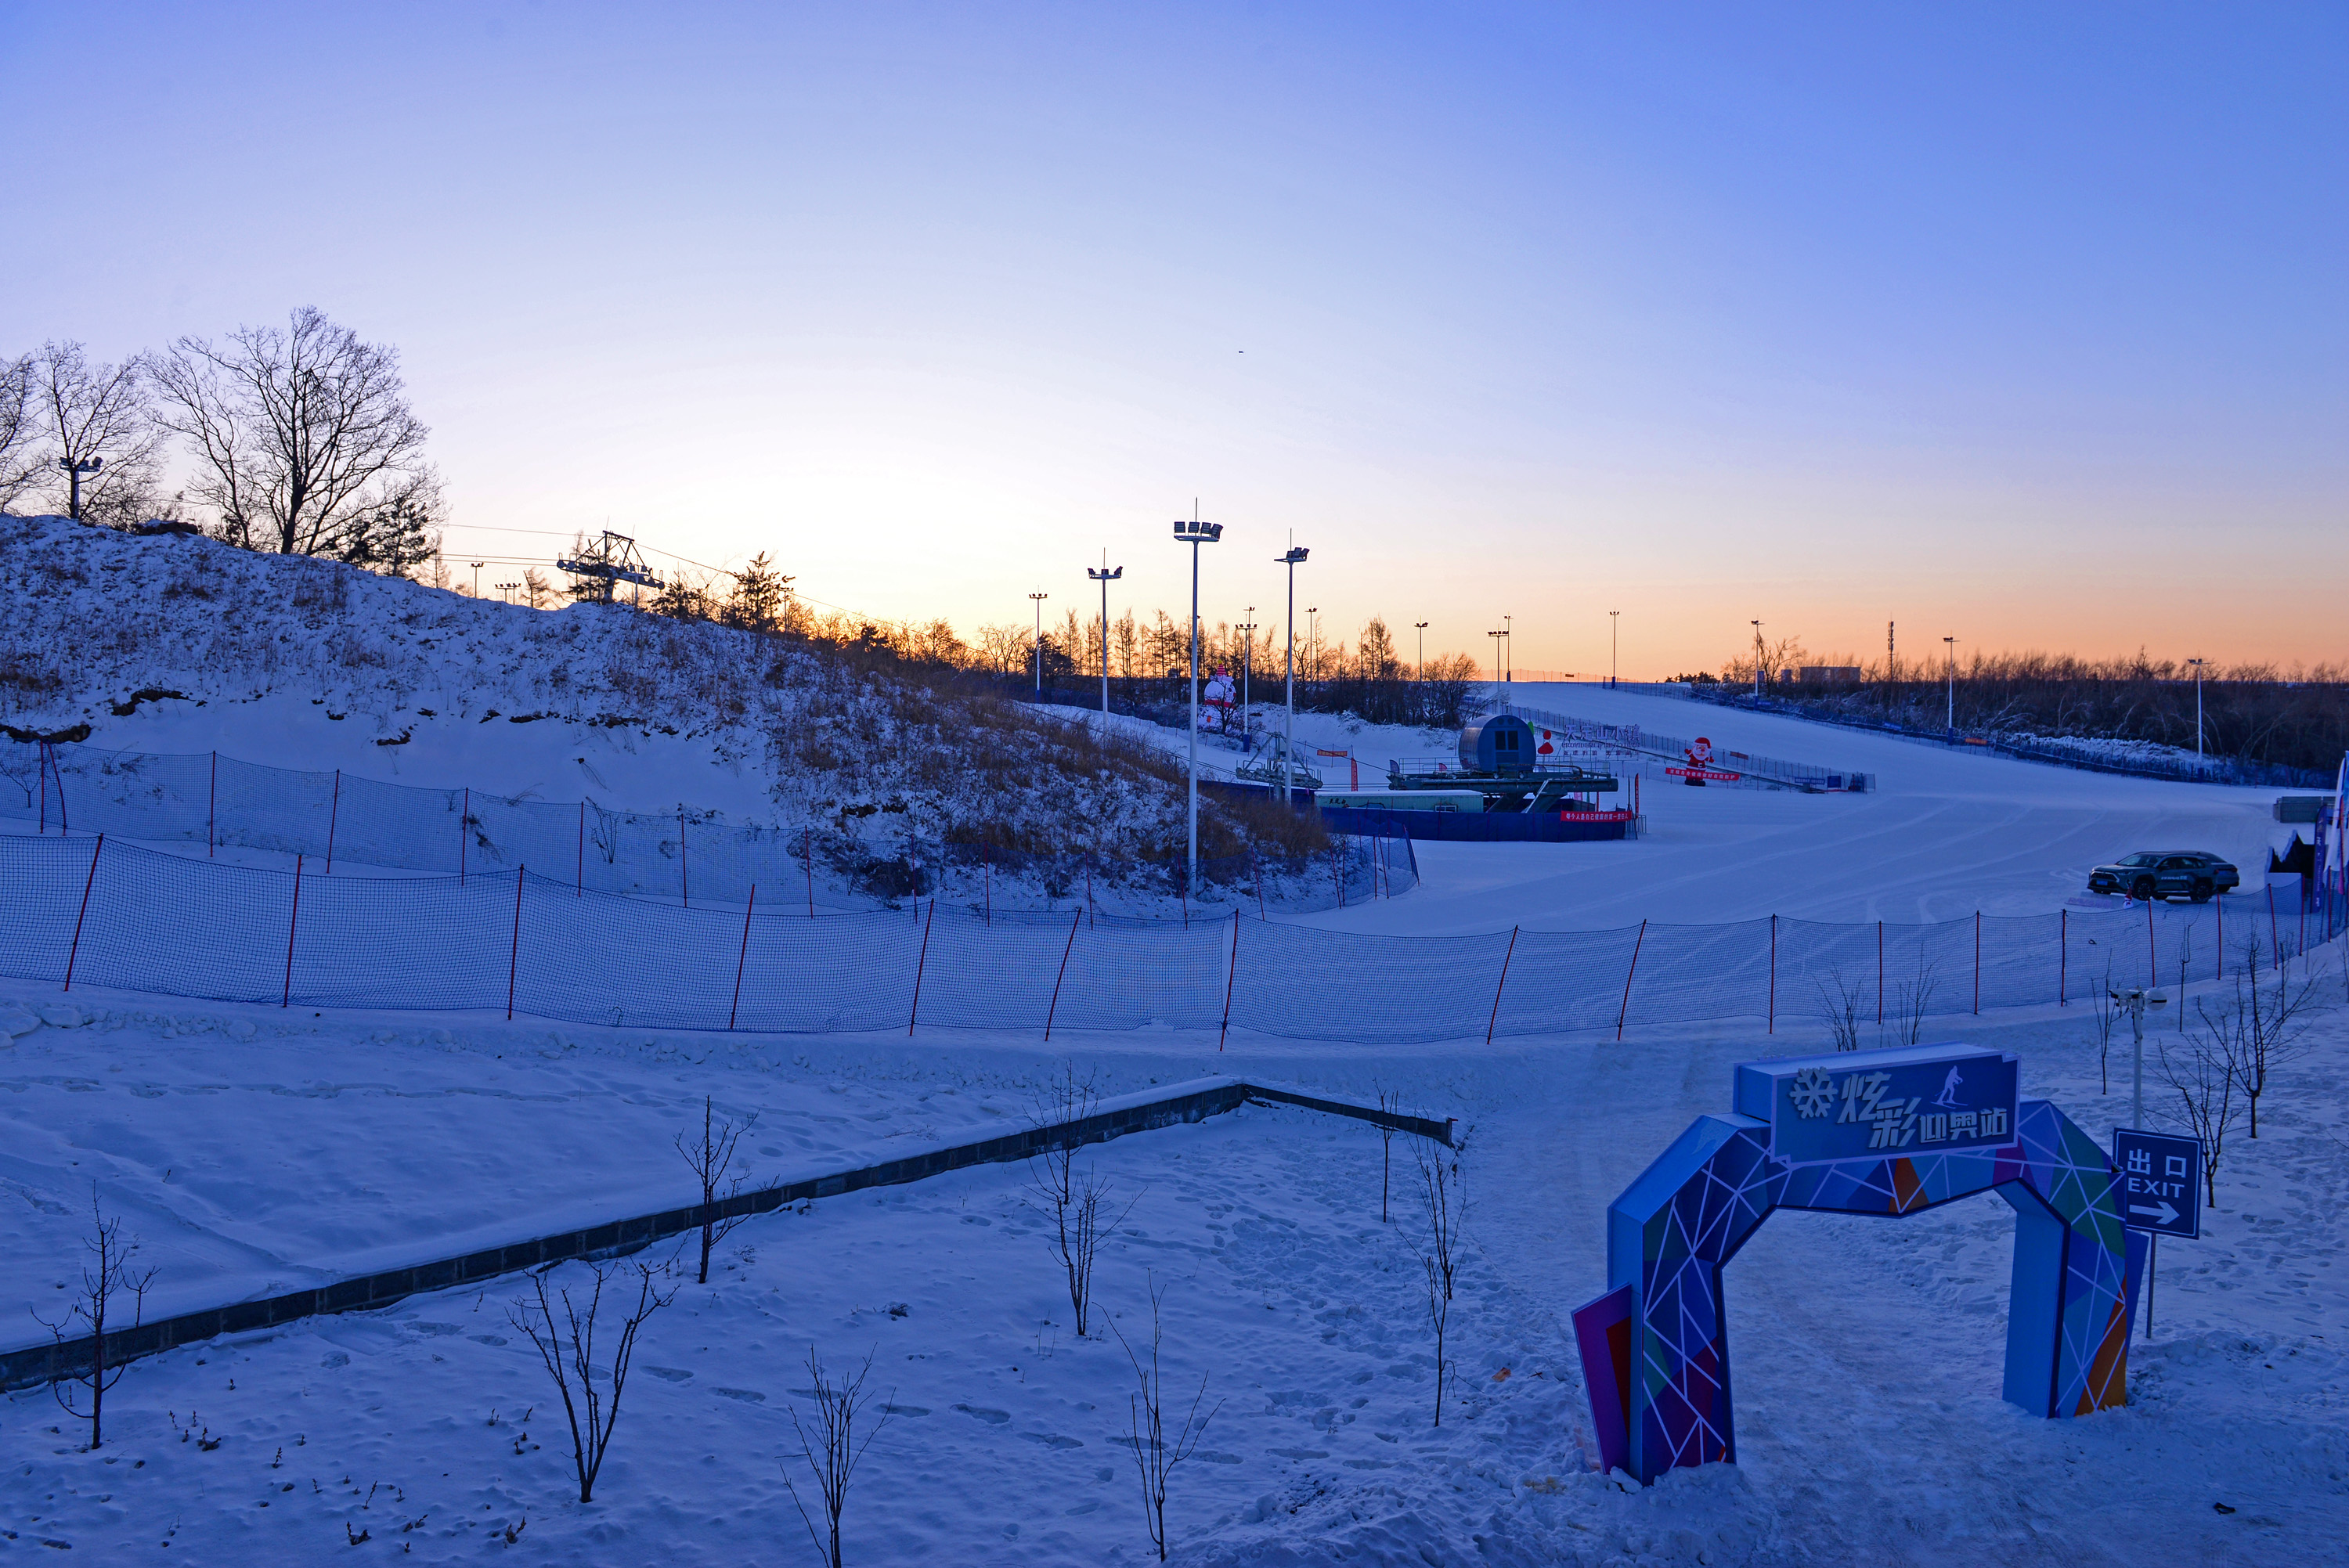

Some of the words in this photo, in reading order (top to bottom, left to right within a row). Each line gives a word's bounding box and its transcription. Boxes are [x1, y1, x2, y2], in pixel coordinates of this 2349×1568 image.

[1564, 723, 1640, 741] 天定山小镇
[2127, 1148, 2187, 1178] 出口
[2127, 1177, 2185, 1198] EXIT
